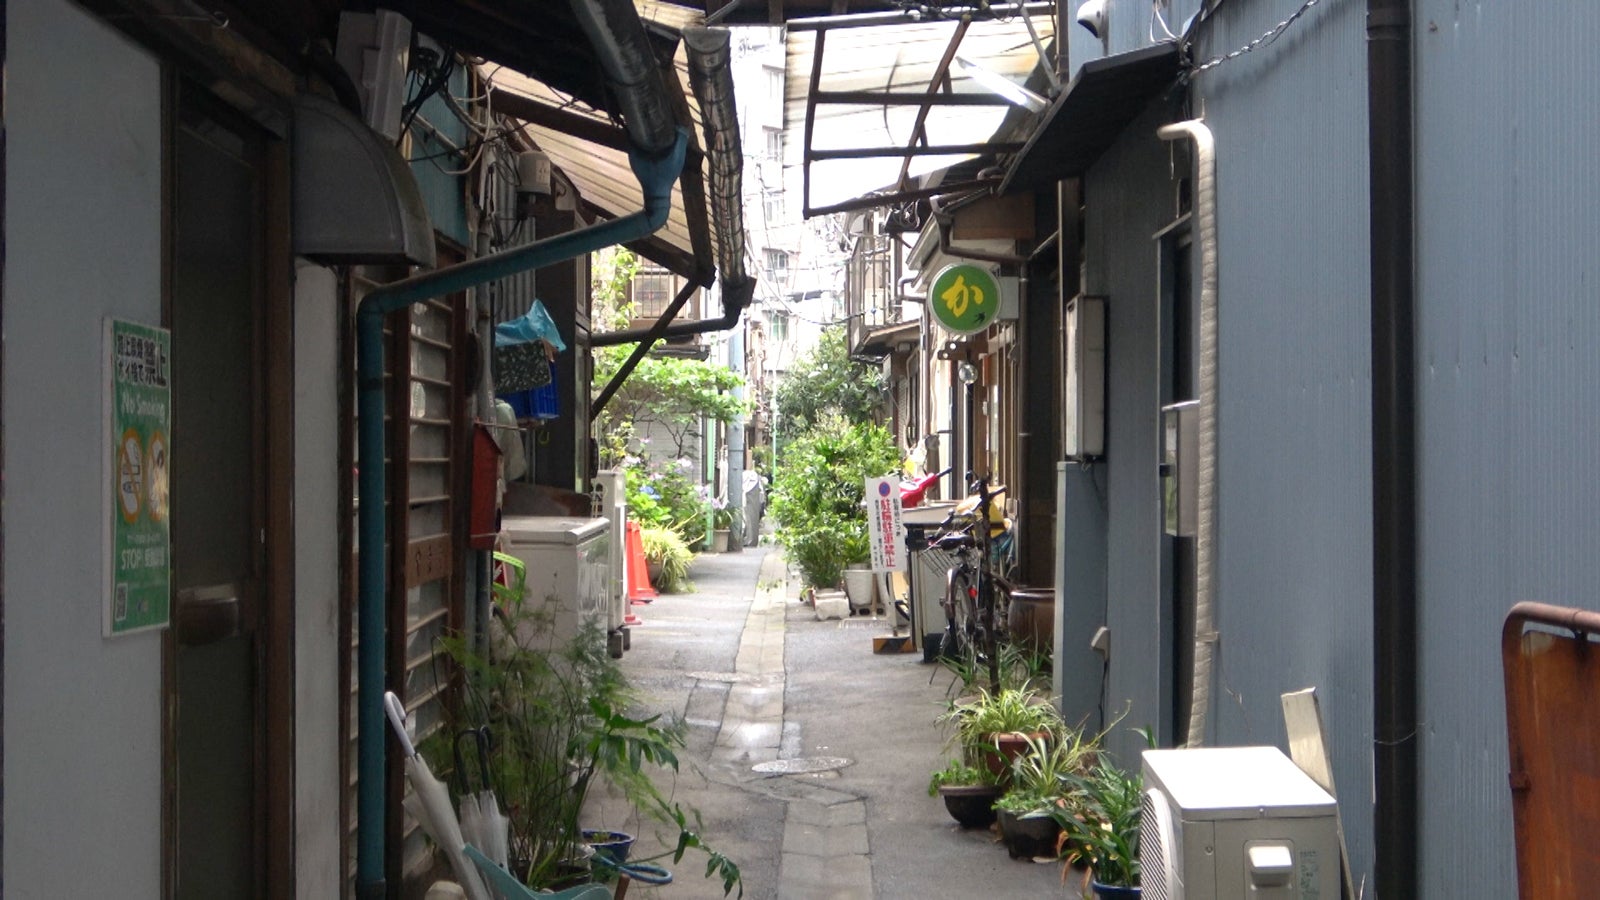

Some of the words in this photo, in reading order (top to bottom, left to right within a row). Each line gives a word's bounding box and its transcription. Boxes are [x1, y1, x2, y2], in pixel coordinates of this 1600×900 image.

[941, 275, 984, 317] か
[144, 340, 166, 386] 禁止
[122, 391, 135, 415] No
[881, 498, 896, 568] 駐輪駐車禁止
